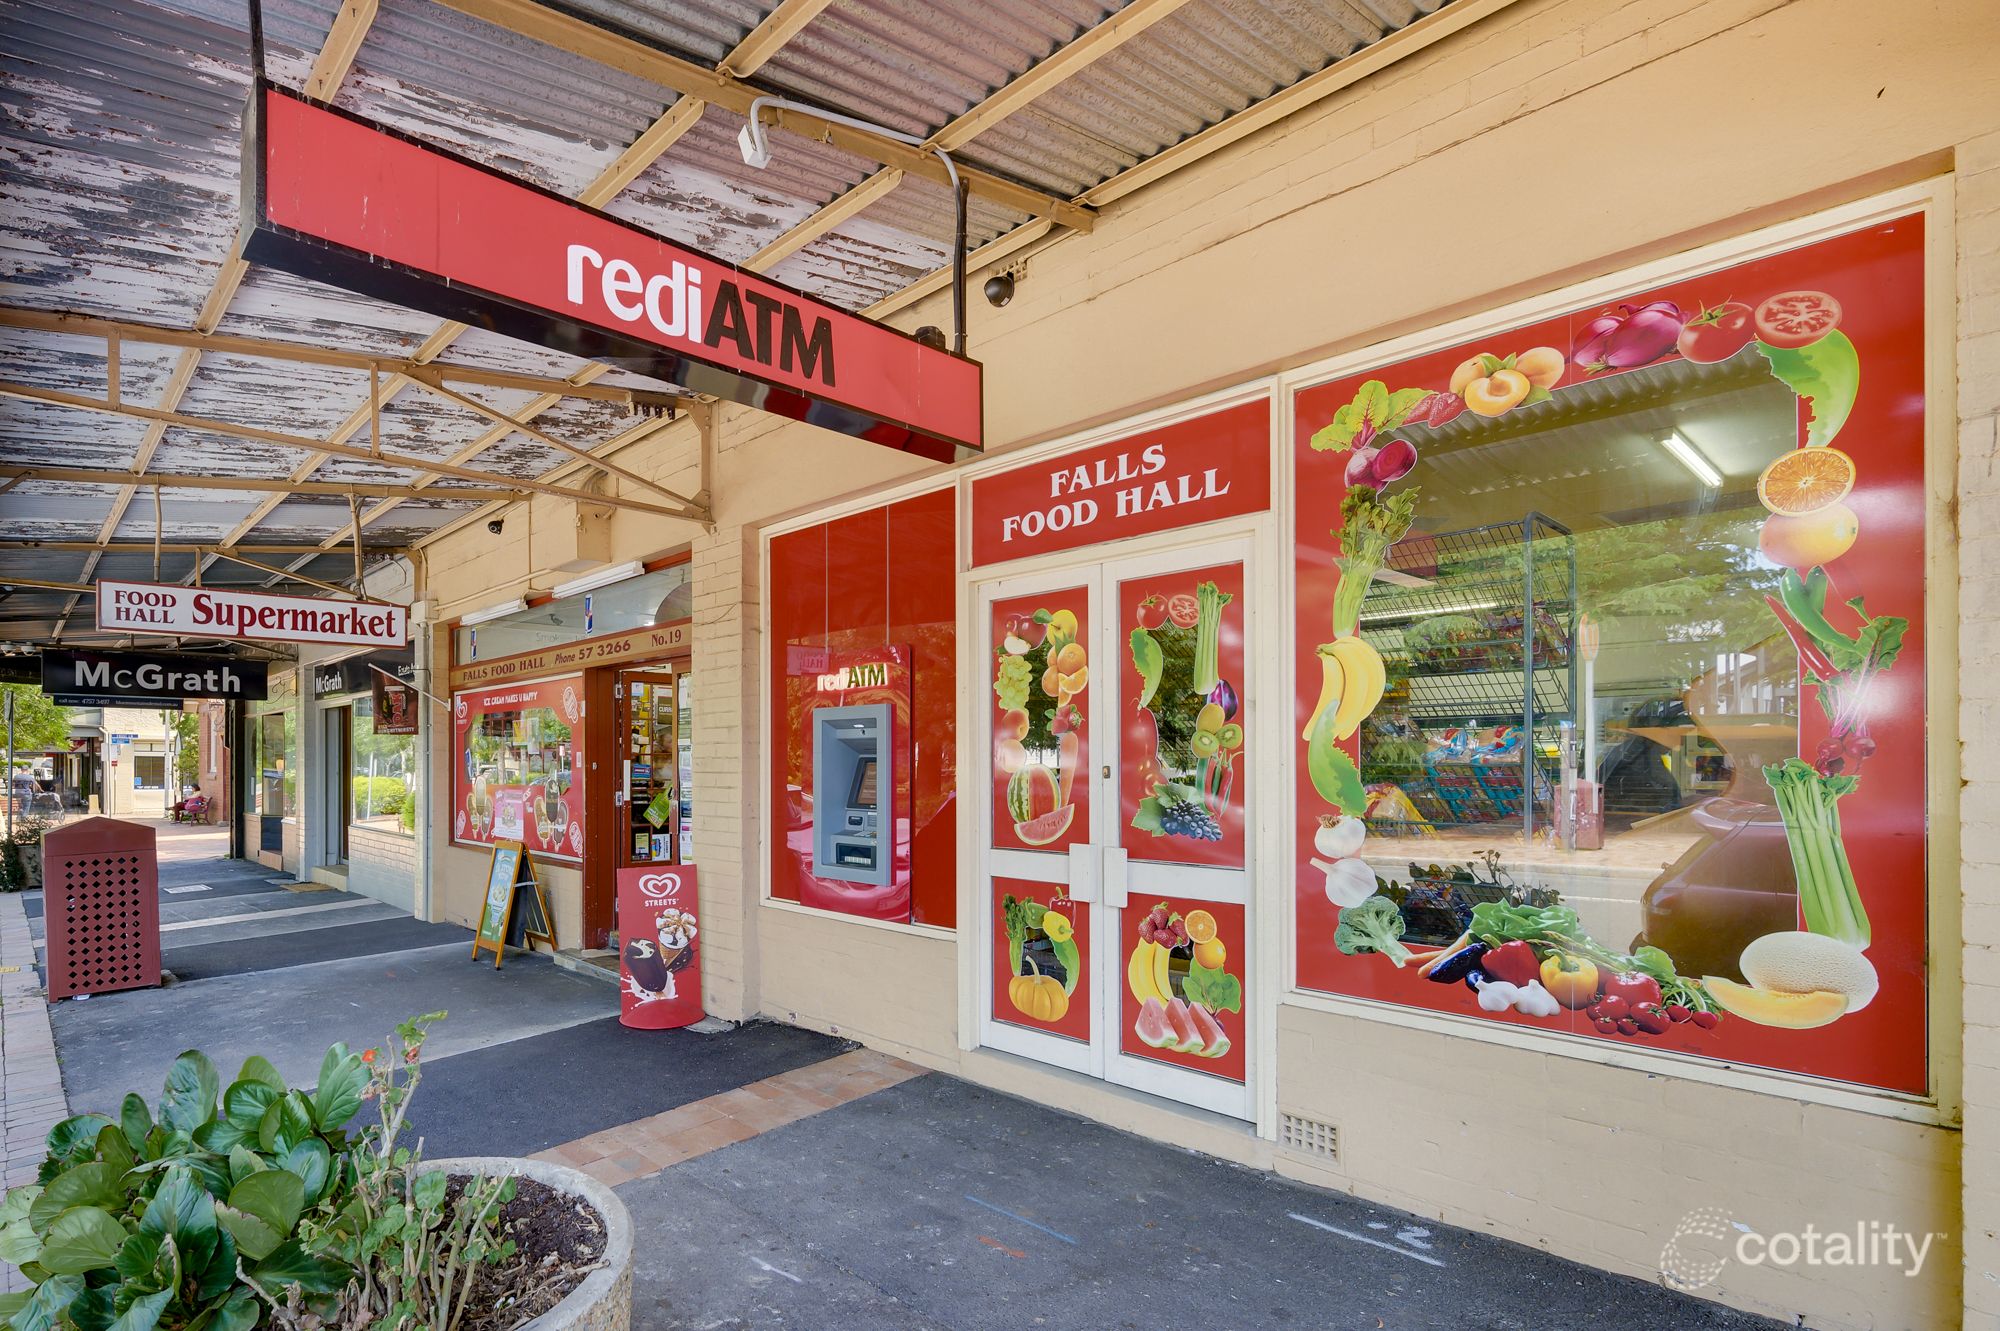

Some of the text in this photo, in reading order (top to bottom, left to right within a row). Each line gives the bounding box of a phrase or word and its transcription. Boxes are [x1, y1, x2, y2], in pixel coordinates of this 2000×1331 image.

[567, 244, 836, 387] rediATM
[1050, 444, 1167, 498] FALLS
[1002, 468, 1231, 542] FOOD HALL
[114, 590, 177, 607] FOOD
[115, 606, 175, 624] HALL
[192, 594, 397, 638] Supermarket
[463, 629, 683, 681] FALLS FOOD HALL Phone 57 3266 No.19
[75, 660, 240, 693] McGrath
[316, 671, 342, 693] McGrath
[817, 662, 888, 691] rediATM
[645, 899, 677, 907] STREETS
